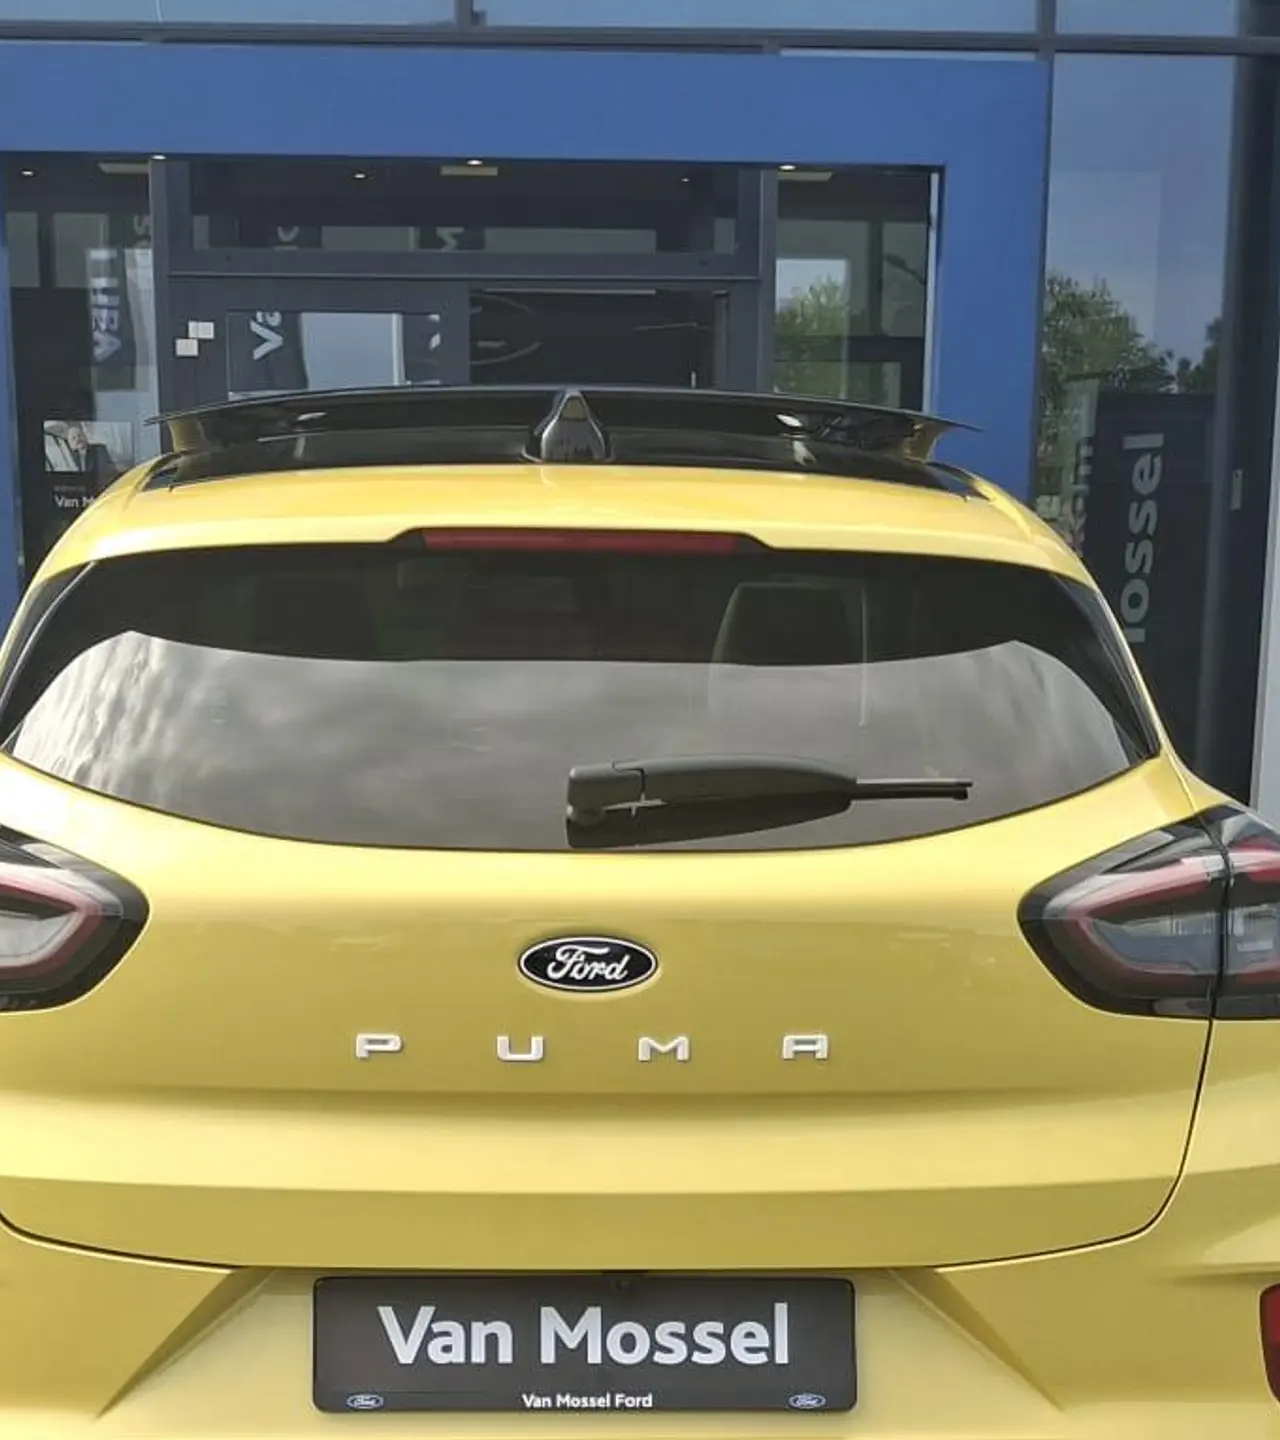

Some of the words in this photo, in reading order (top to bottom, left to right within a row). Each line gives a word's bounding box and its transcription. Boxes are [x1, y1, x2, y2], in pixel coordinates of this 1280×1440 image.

[547, 945, 631, 981] Ford
[355, 1033, 829, 1061] PUMA
[378, 1306, 512, 1364] Van
[541, 1303, 788, 1364] Mossel
[522, 1394, 551, 1408] Van
[557, 1393, 610, 1409] Mossel
[615, 1393, 652, 1409] Ford
